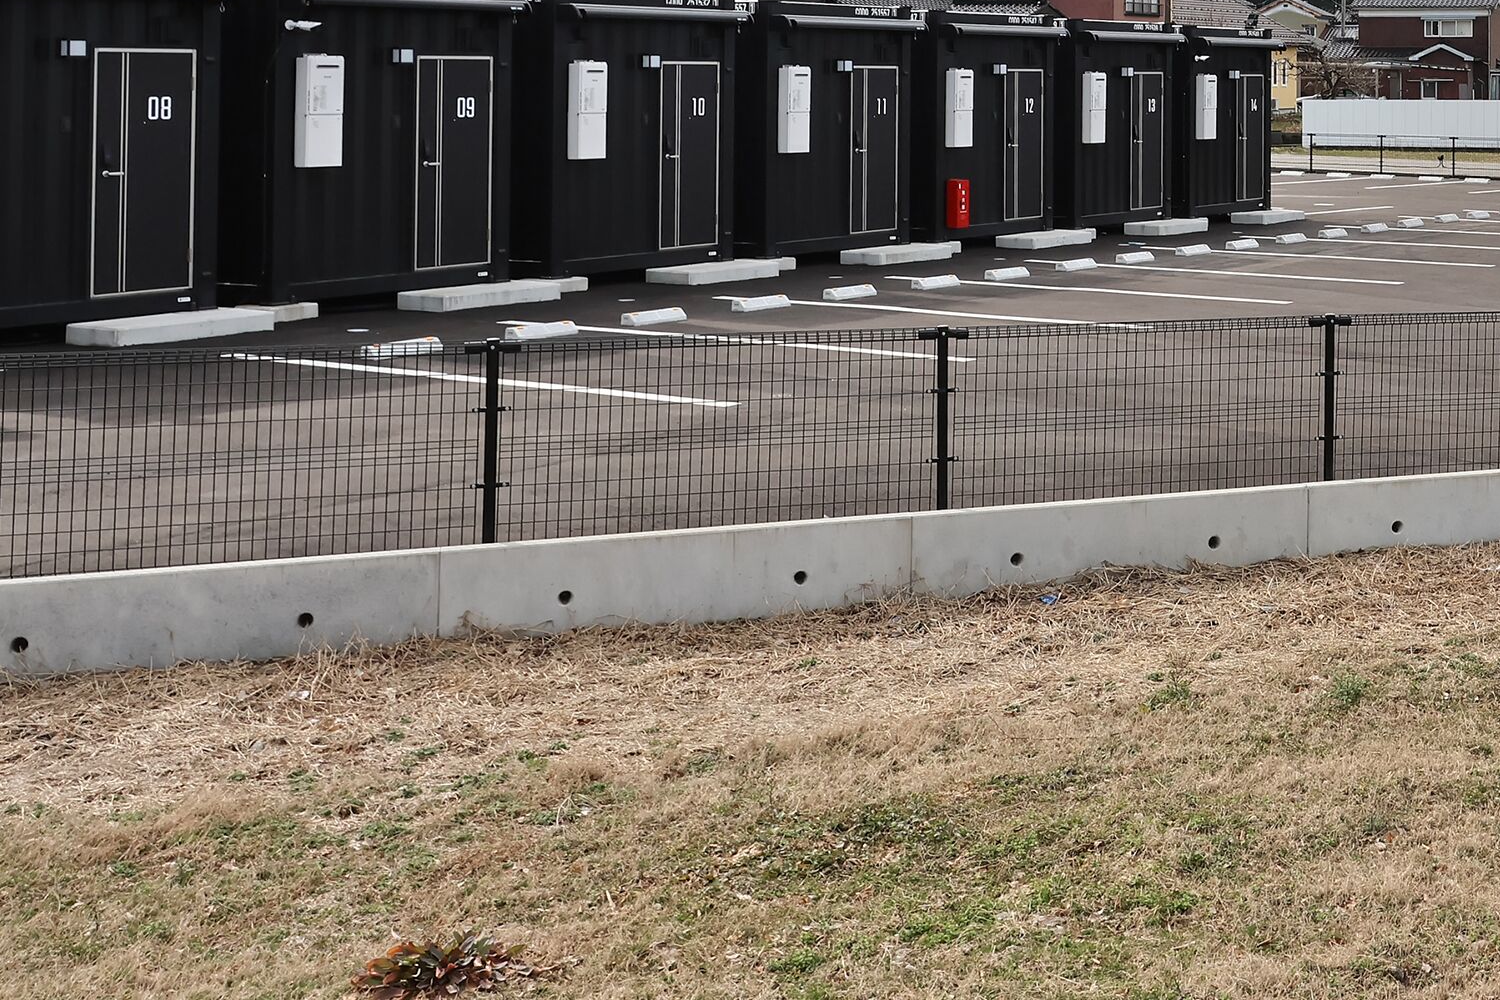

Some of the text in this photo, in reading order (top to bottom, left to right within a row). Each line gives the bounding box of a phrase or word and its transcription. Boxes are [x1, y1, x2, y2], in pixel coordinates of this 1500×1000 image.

[148, 96, 172, 120] 08
[457, 97, 475, 118] 09
[692, 97, 705, 116] 10
[877, 98, 886, 115] 11
[1025, 97, 1034, 113] 12
[1148, 98, 1156, 112] 13
[1250, 98, 1258, 111] 14
